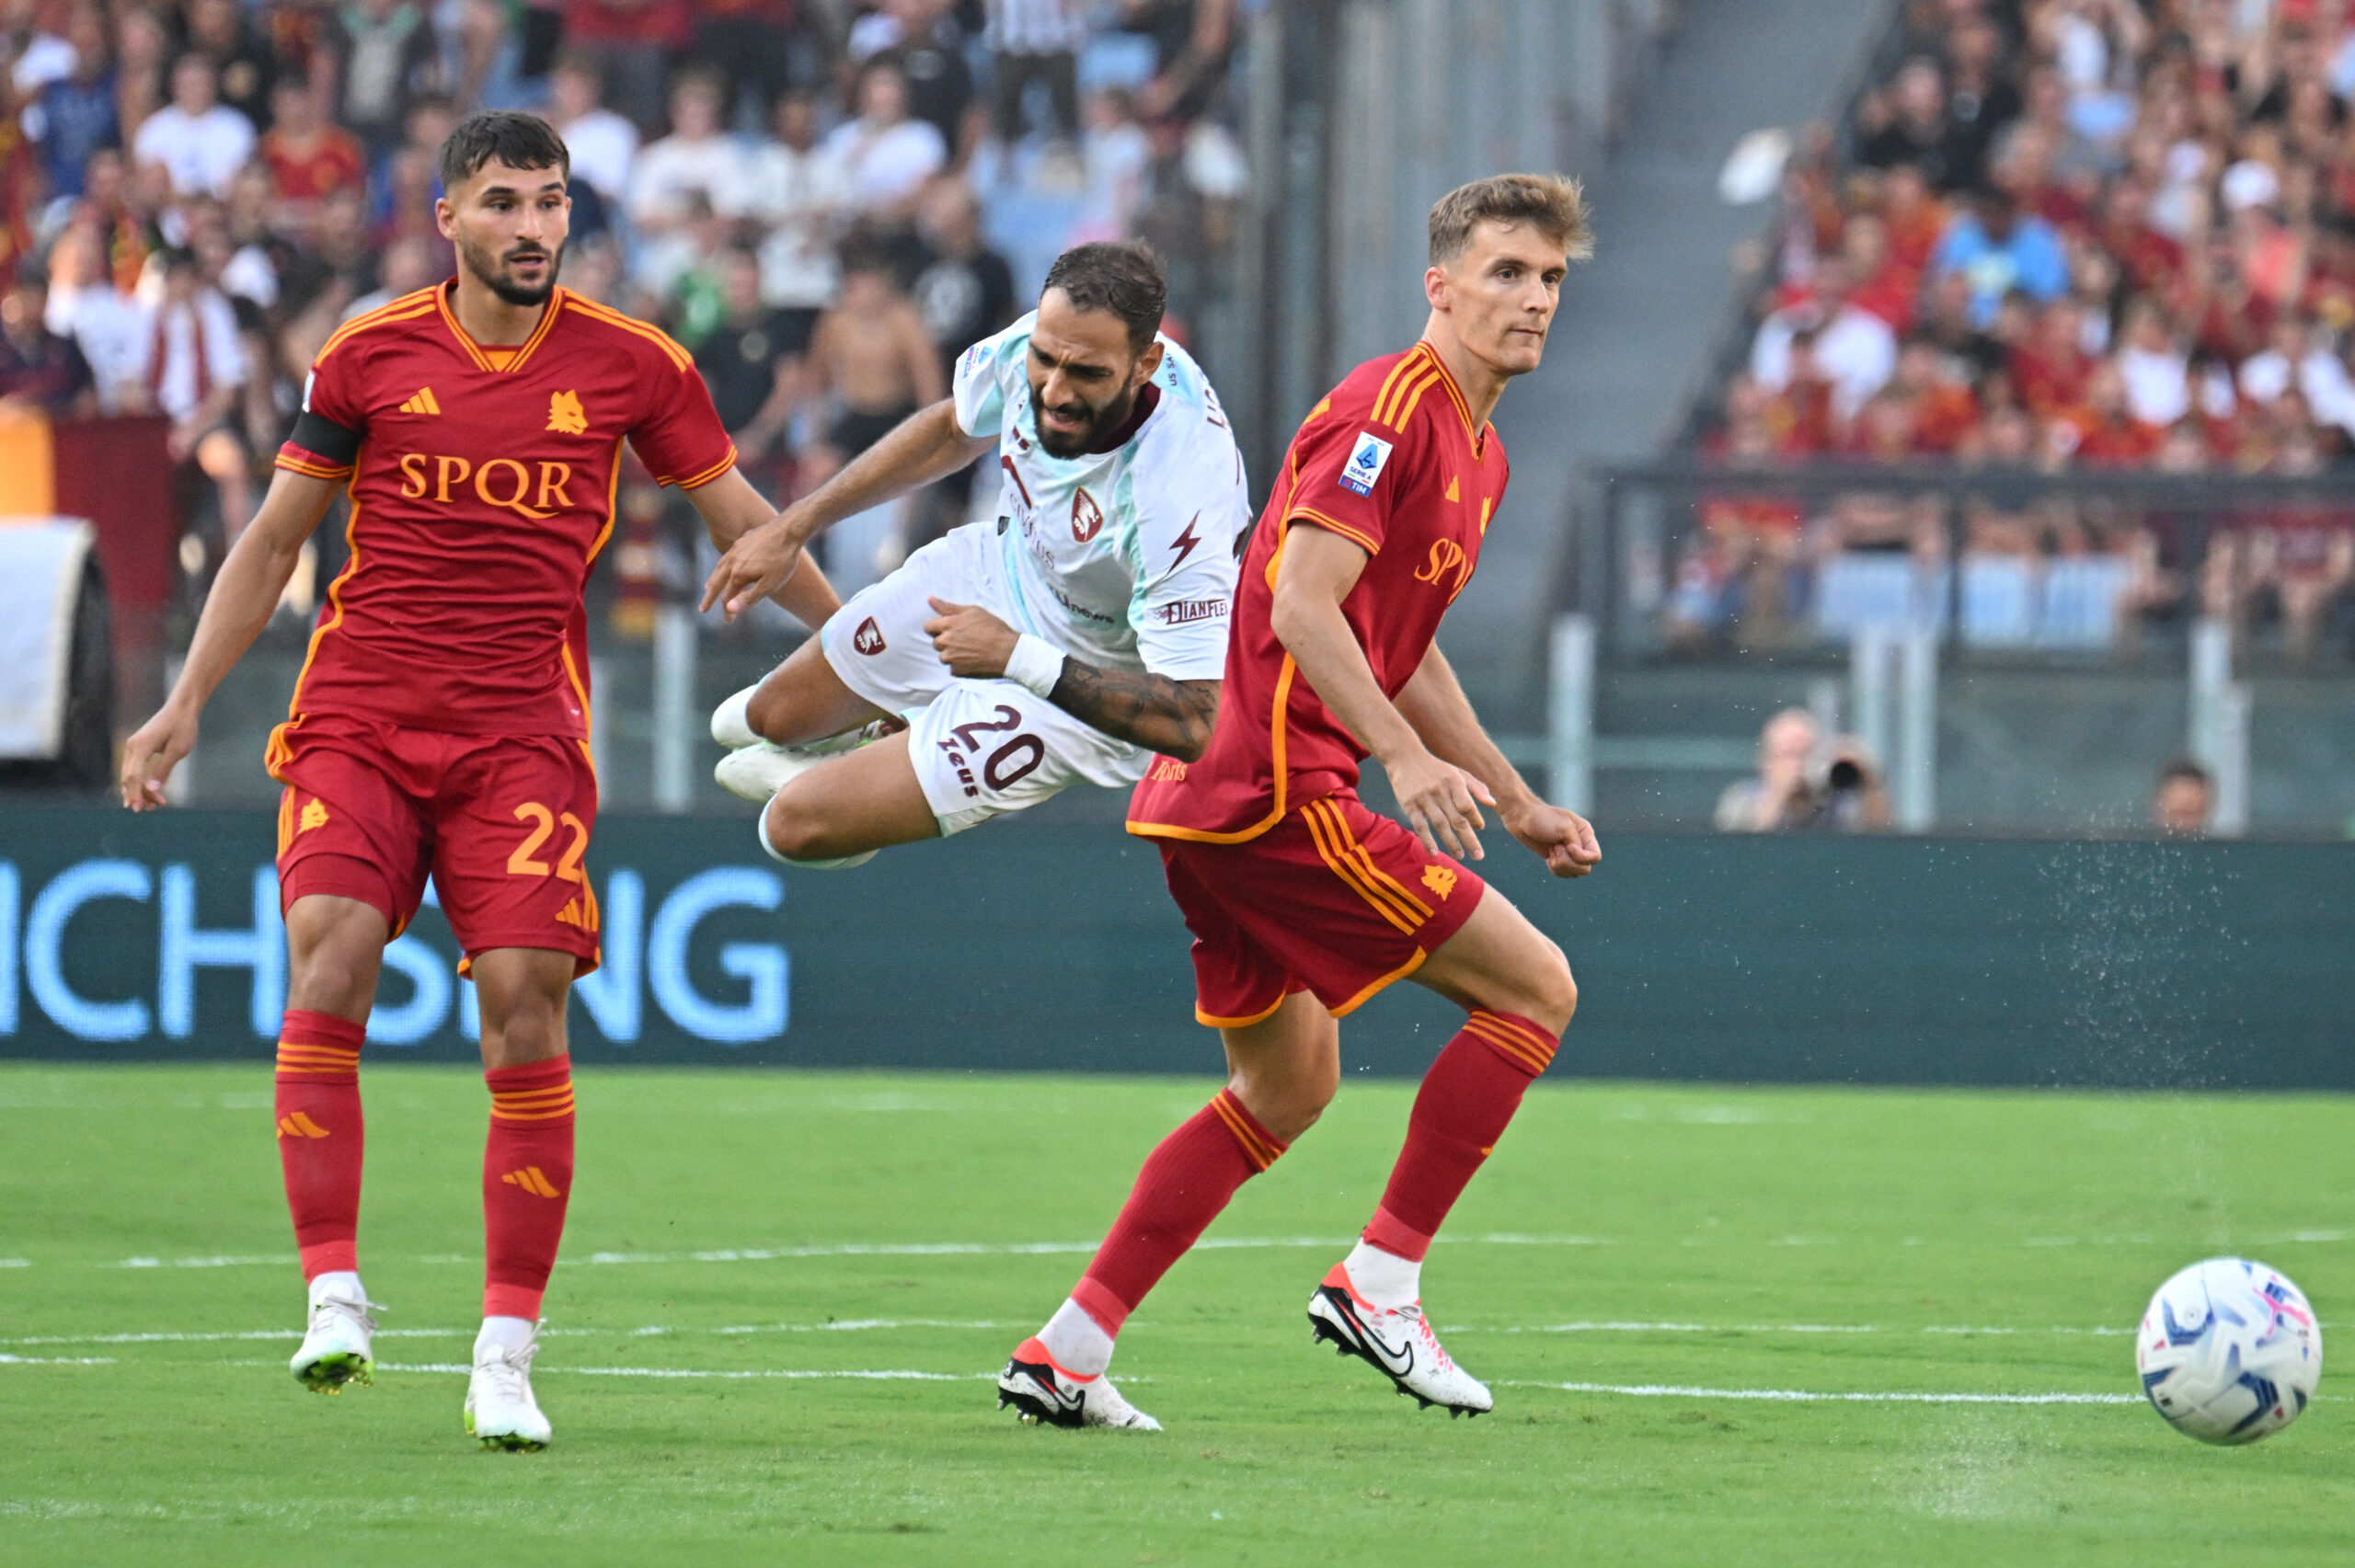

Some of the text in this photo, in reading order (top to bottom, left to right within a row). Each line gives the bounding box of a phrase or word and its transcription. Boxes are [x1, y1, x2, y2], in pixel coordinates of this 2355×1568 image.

[1168, 372, 1178, 386] US
[399, 452, 576, 521] SPQR
[1350, 466, 1367, 478] SERIE
[1352, 482, 1367, 495] TIM
[950, 704, 1045, 792] 20
[507, 801, 589, 884] 22
